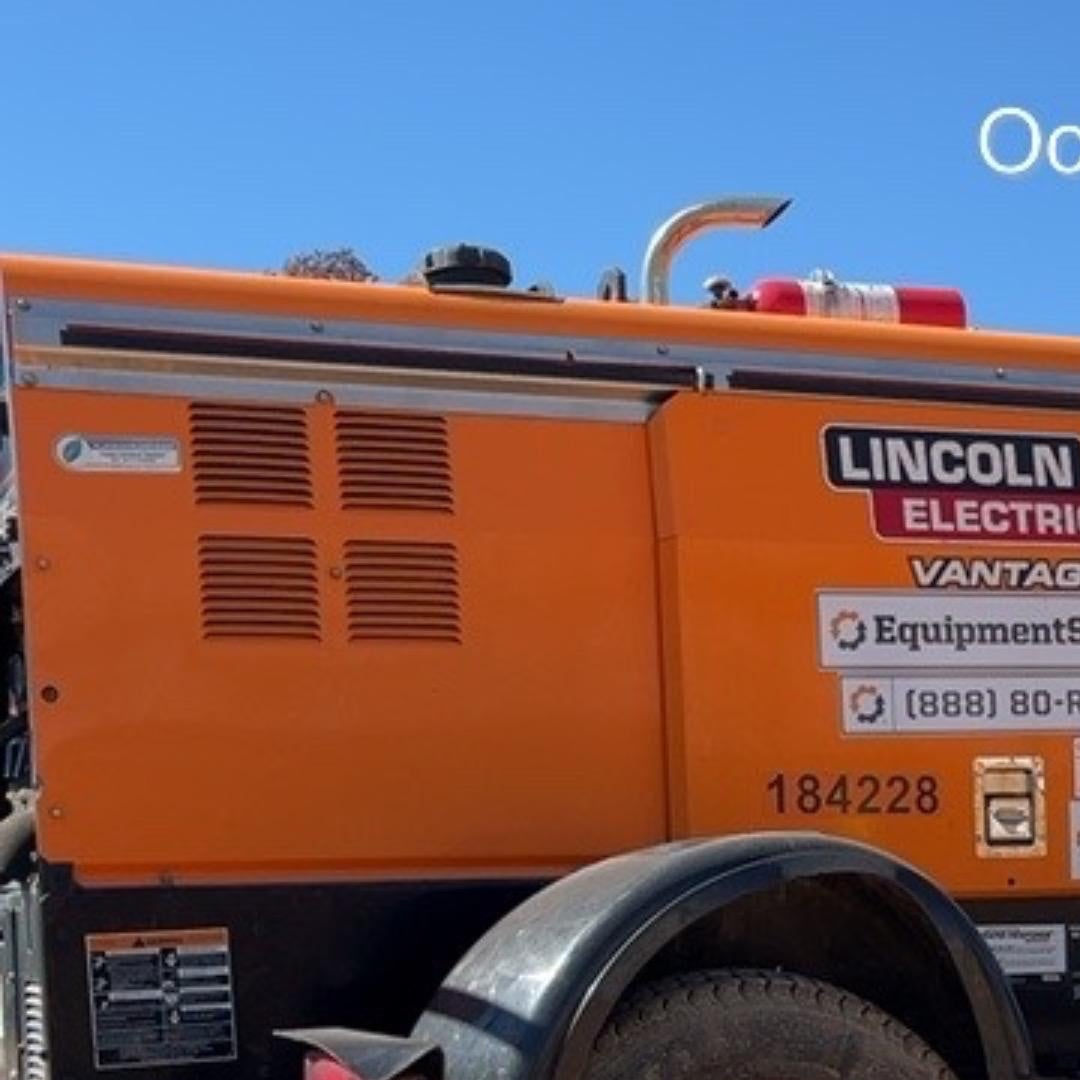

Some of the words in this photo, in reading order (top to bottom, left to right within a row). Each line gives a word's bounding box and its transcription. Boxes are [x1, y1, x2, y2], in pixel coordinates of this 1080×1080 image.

[838, 435, 1073, 489] LINCOLN
[905, 688, 998, 720] (888)
[767, 773, 939, 815] 184228
